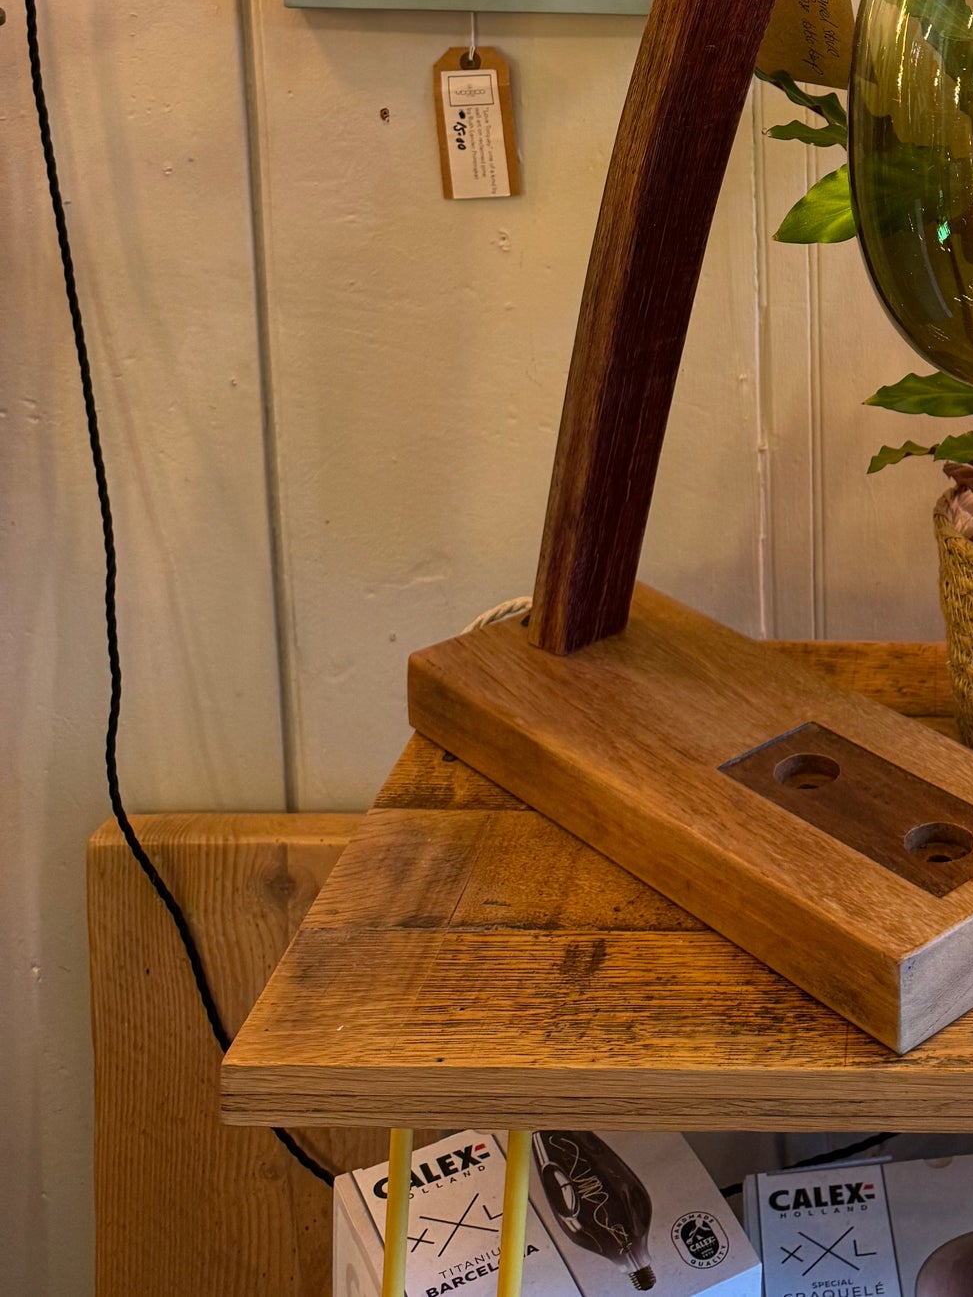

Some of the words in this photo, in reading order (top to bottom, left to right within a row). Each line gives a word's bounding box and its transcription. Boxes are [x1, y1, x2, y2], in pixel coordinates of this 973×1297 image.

[373, 1145, 481, 1199] CALEX
[409, 1165, 485, 1200] OLLAND
[769, 1182, 866, 1212] CALEX
[780, 1204, 868, 1219] HOLLAND
[407, 1193, 503, 1257] XXL
[674, 1214, 714, 1240] HANDMADE
[689, 1236, 714, 1252] CALEX
[690, 1245, 726, 1267] QUALITY
[780, 1226, 877, 1276] XXL
[426, 1244, 539, 1297] BARCELA
[438, 1247, 501, 1279] TITANIU
[812, 1279, 854, 1289] SPECIAL
